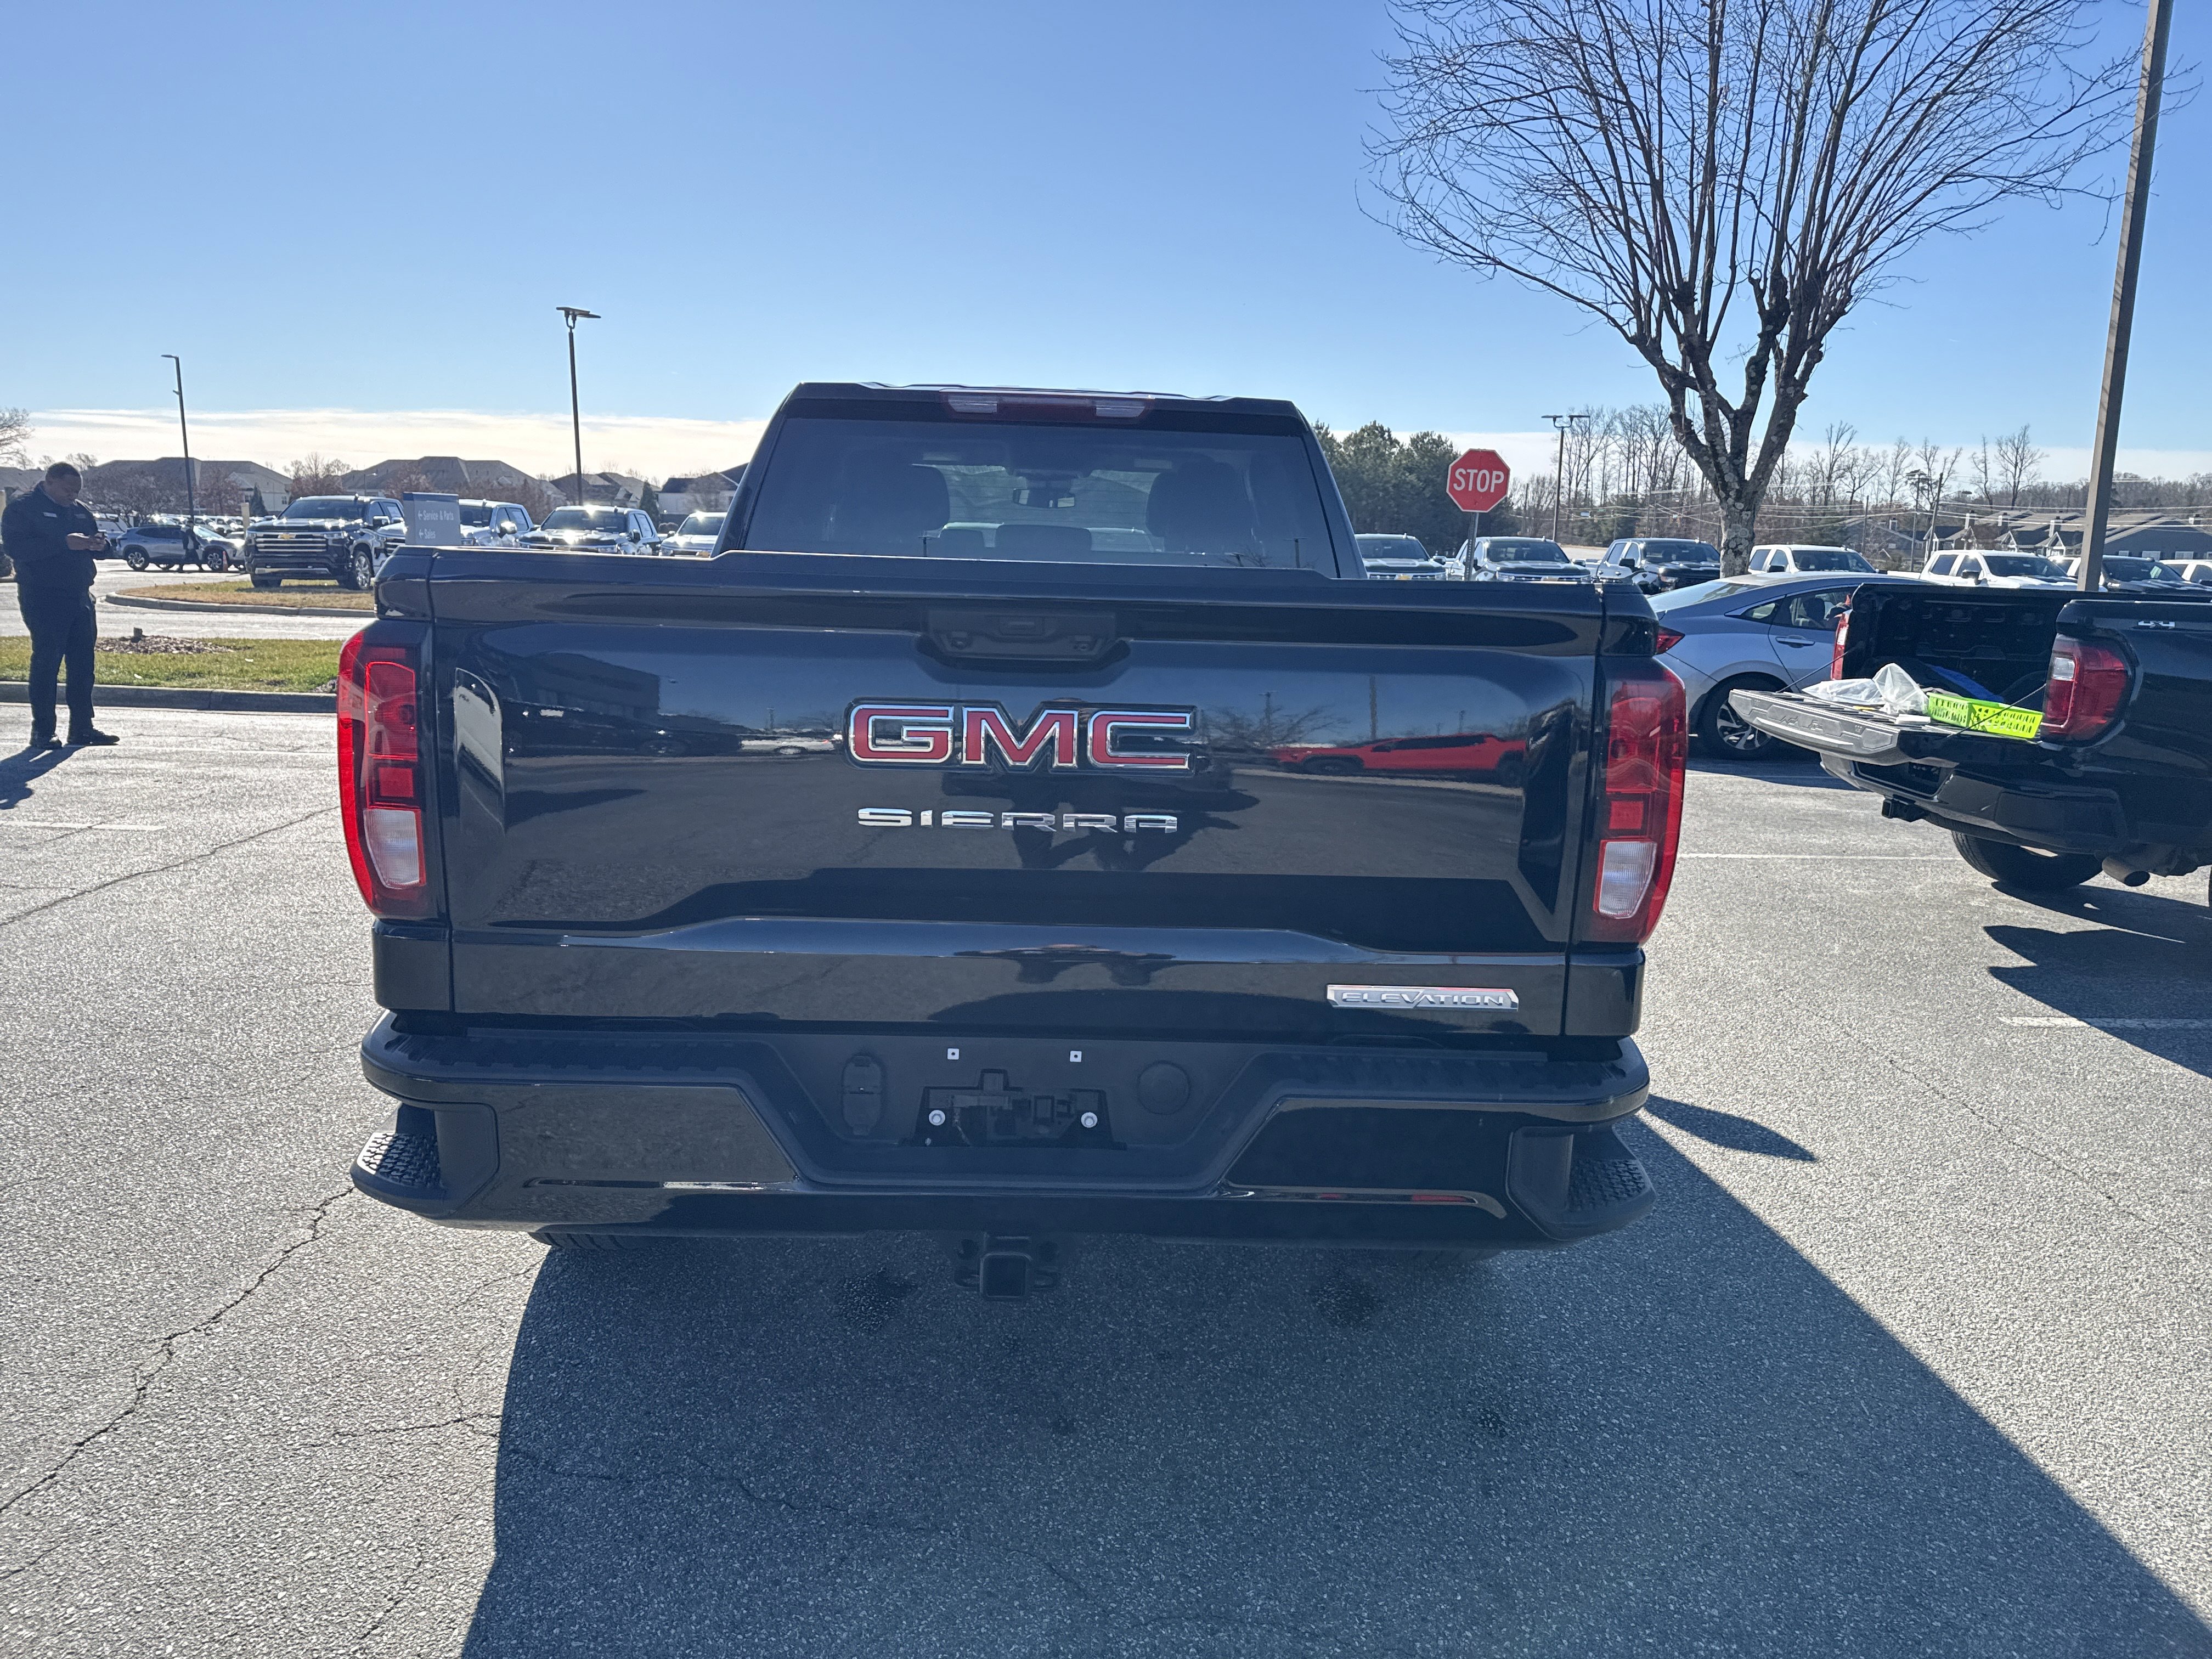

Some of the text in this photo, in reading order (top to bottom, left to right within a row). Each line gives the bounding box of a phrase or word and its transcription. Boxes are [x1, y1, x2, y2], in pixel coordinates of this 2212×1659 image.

[1453, 468, 1504, 493] STOP
[423, 510, 454, 521] Service & Parts
[424, 529, 436, 539] Sales
[849, 704, 1192, 769] GMC
[857, 808, 1178, 833] SIERRA
[1342, 991, 1503, 1006] ELEVATION
